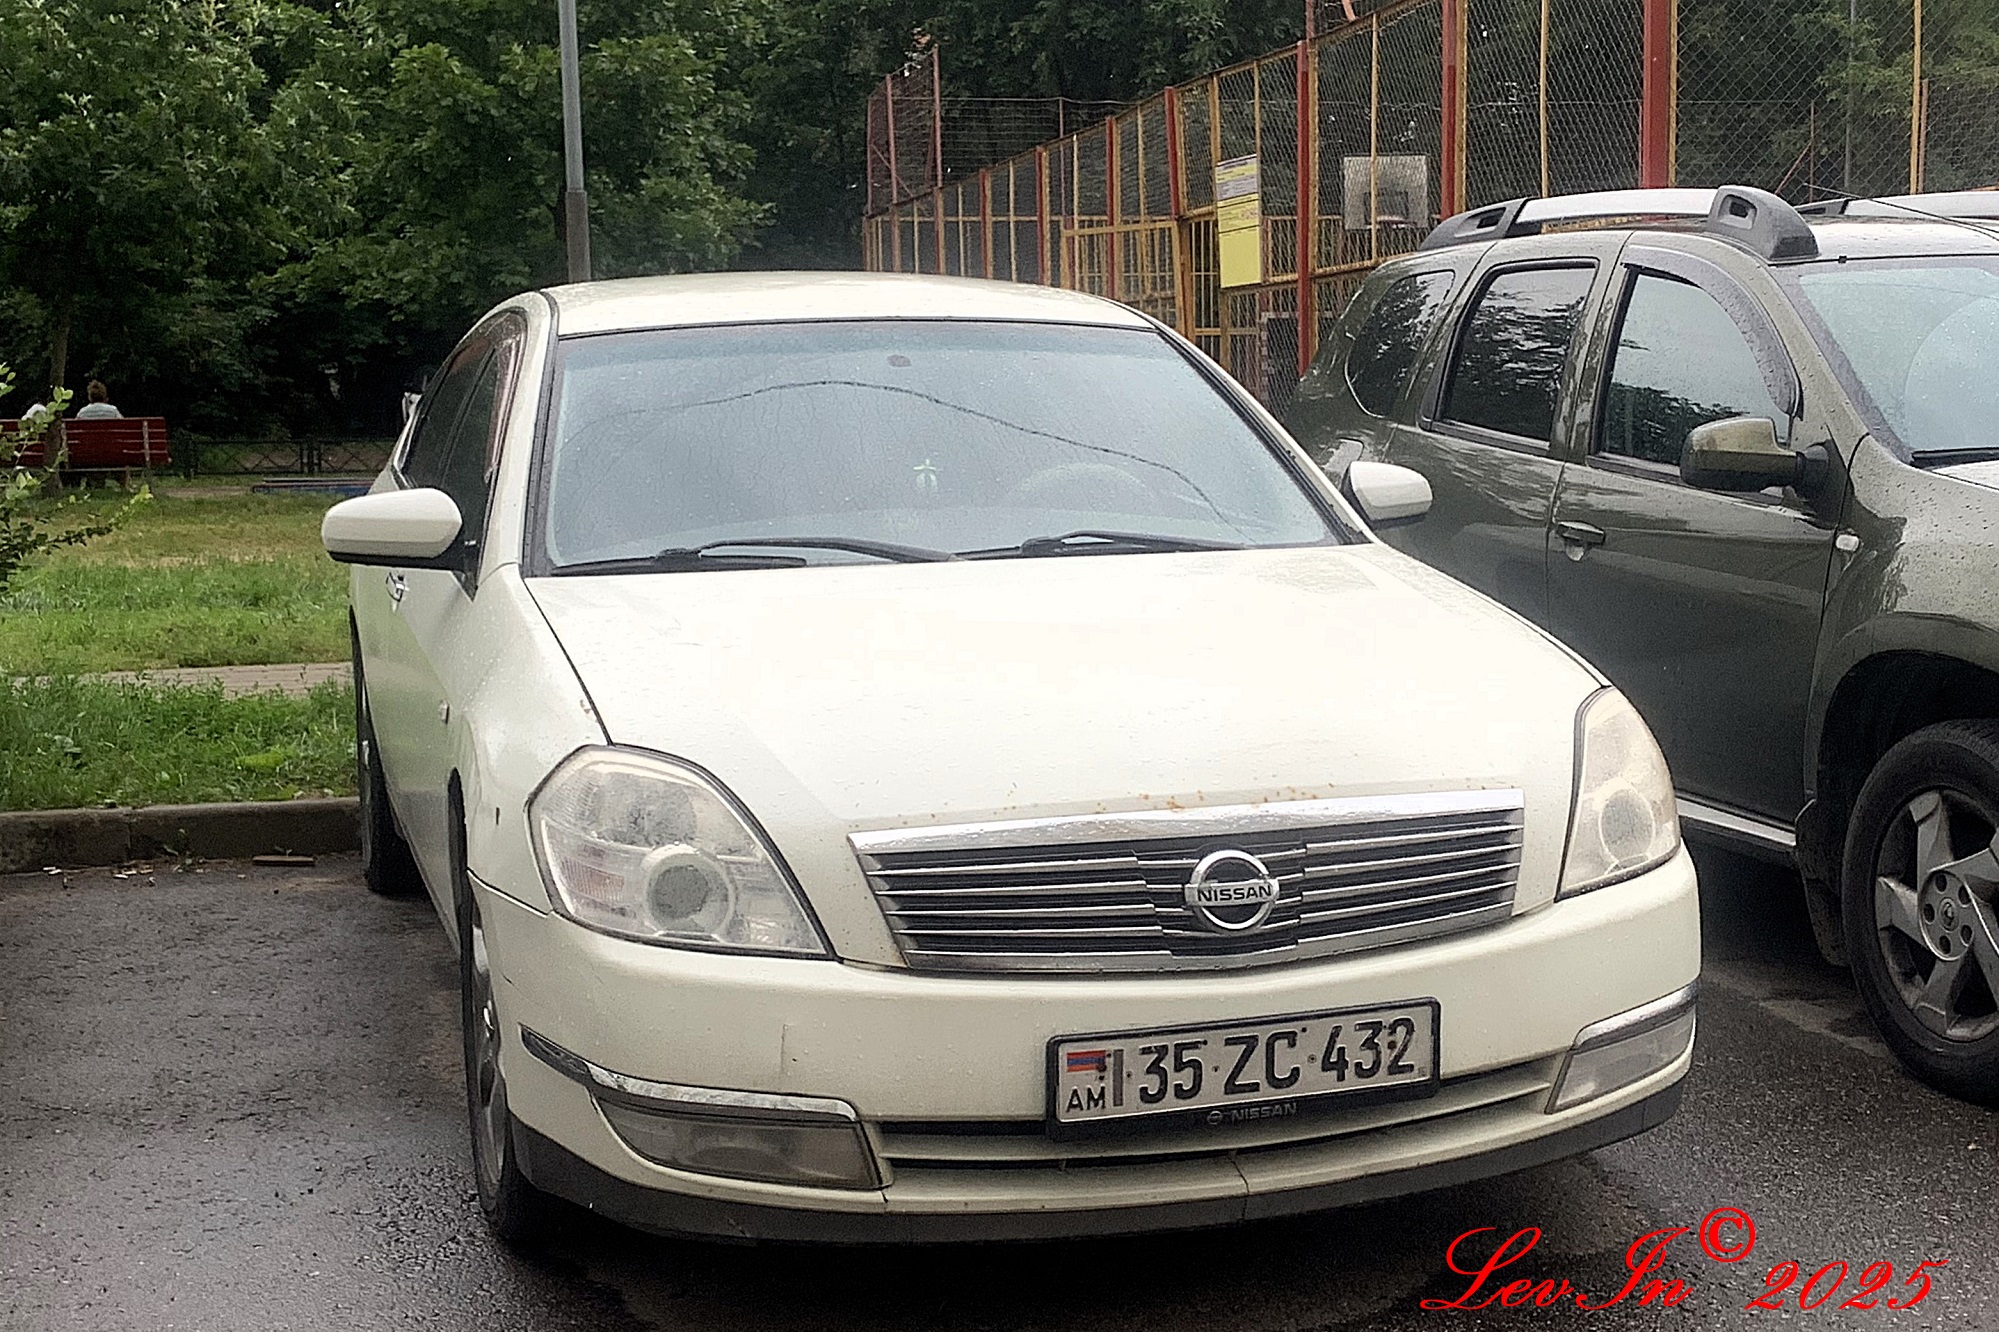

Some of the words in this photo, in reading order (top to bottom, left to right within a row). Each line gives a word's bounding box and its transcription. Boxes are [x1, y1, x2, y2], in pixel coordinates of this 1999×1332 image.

[1198, 885, 1272, 902] NISSAN
[1138, 1041, 1204, 1104] 35
[1223, 1030, 1301, 1096] ZC
[1321, 1017, 1416, 1083] 432
[1066, 1086, 1106, 1112] AM
[1231, 1102, 1297, 1120] NISSAN
